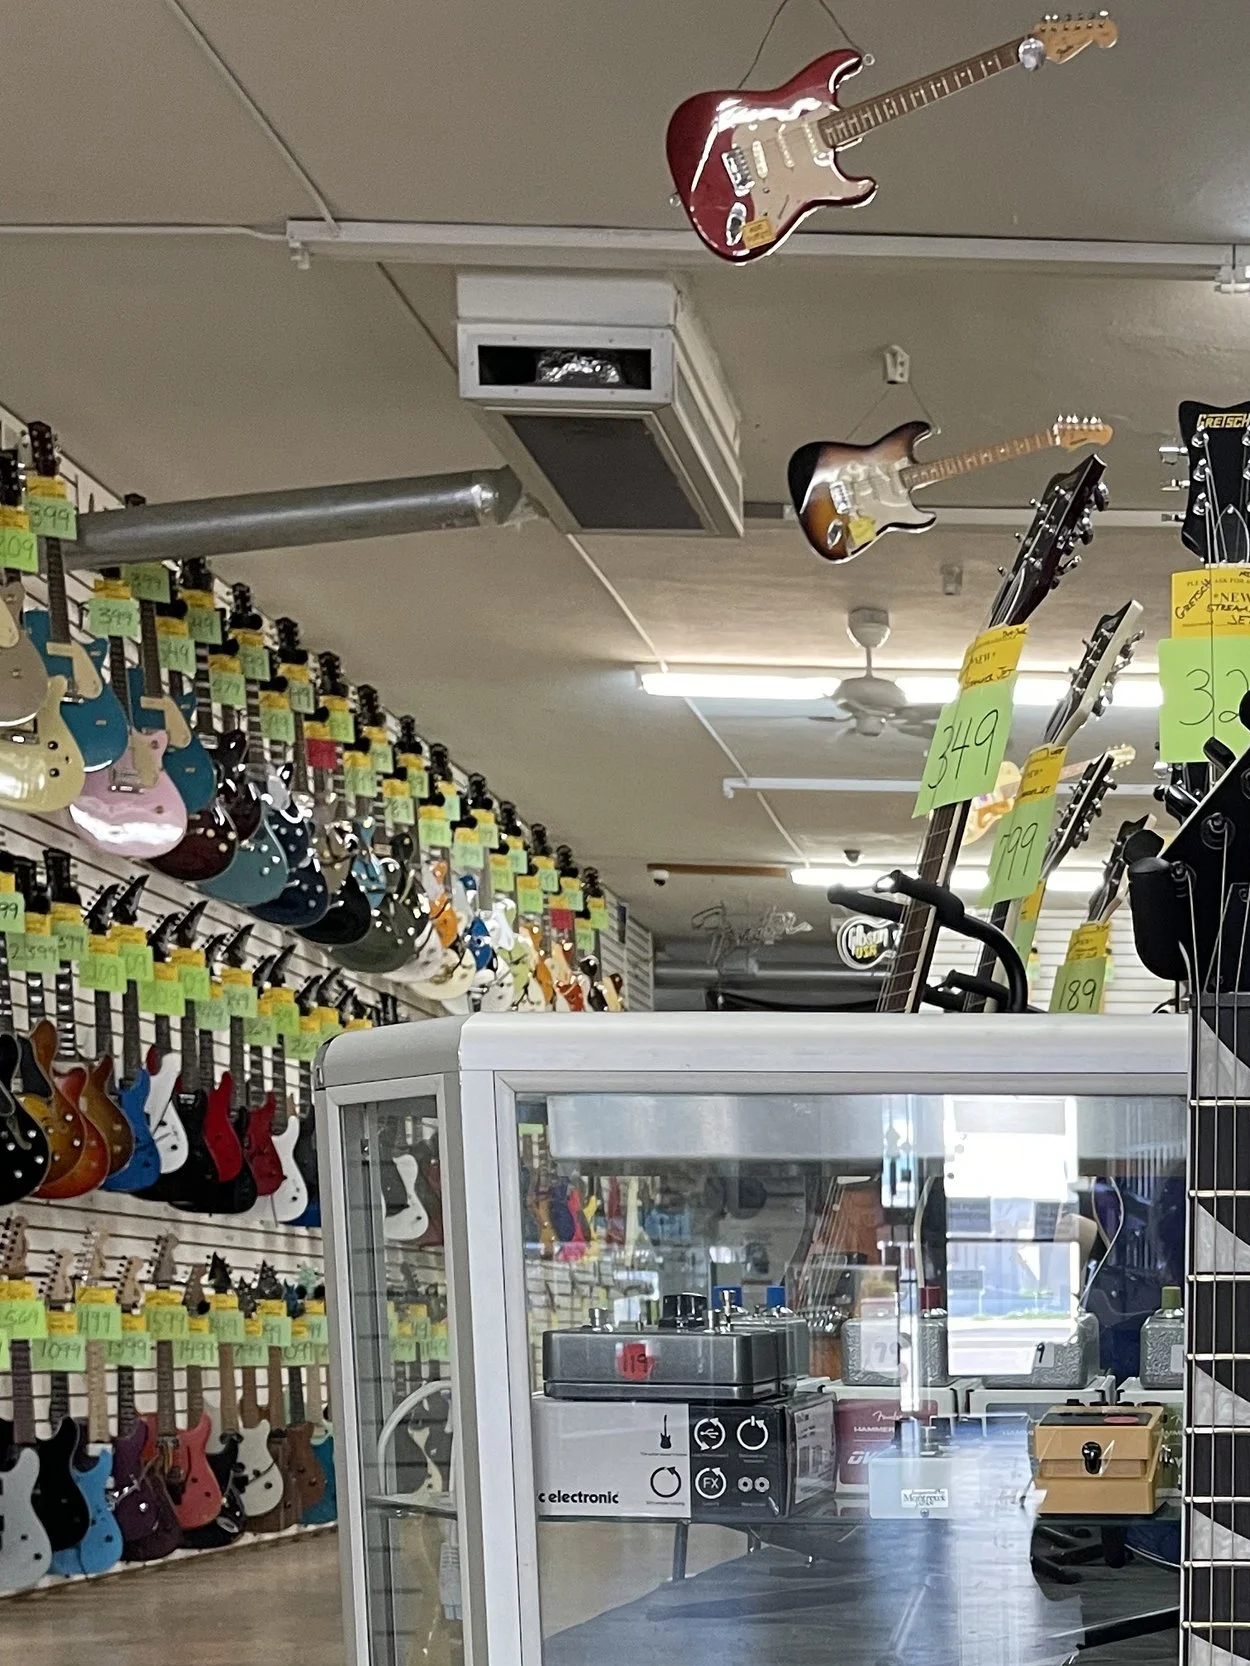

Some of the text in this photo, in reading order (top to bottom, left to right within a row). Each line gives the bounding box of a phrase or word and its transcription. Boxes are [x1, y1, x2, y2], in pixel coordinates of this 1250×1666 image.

[1197, 413, 1250, 429] GRETSCH
[927, 708, 1000, 790] 349
[1058, 978, 1098, 1012] 189
[702, 1477, 719, 1489] FX
[548, 1489, 619, 1504] electronic
